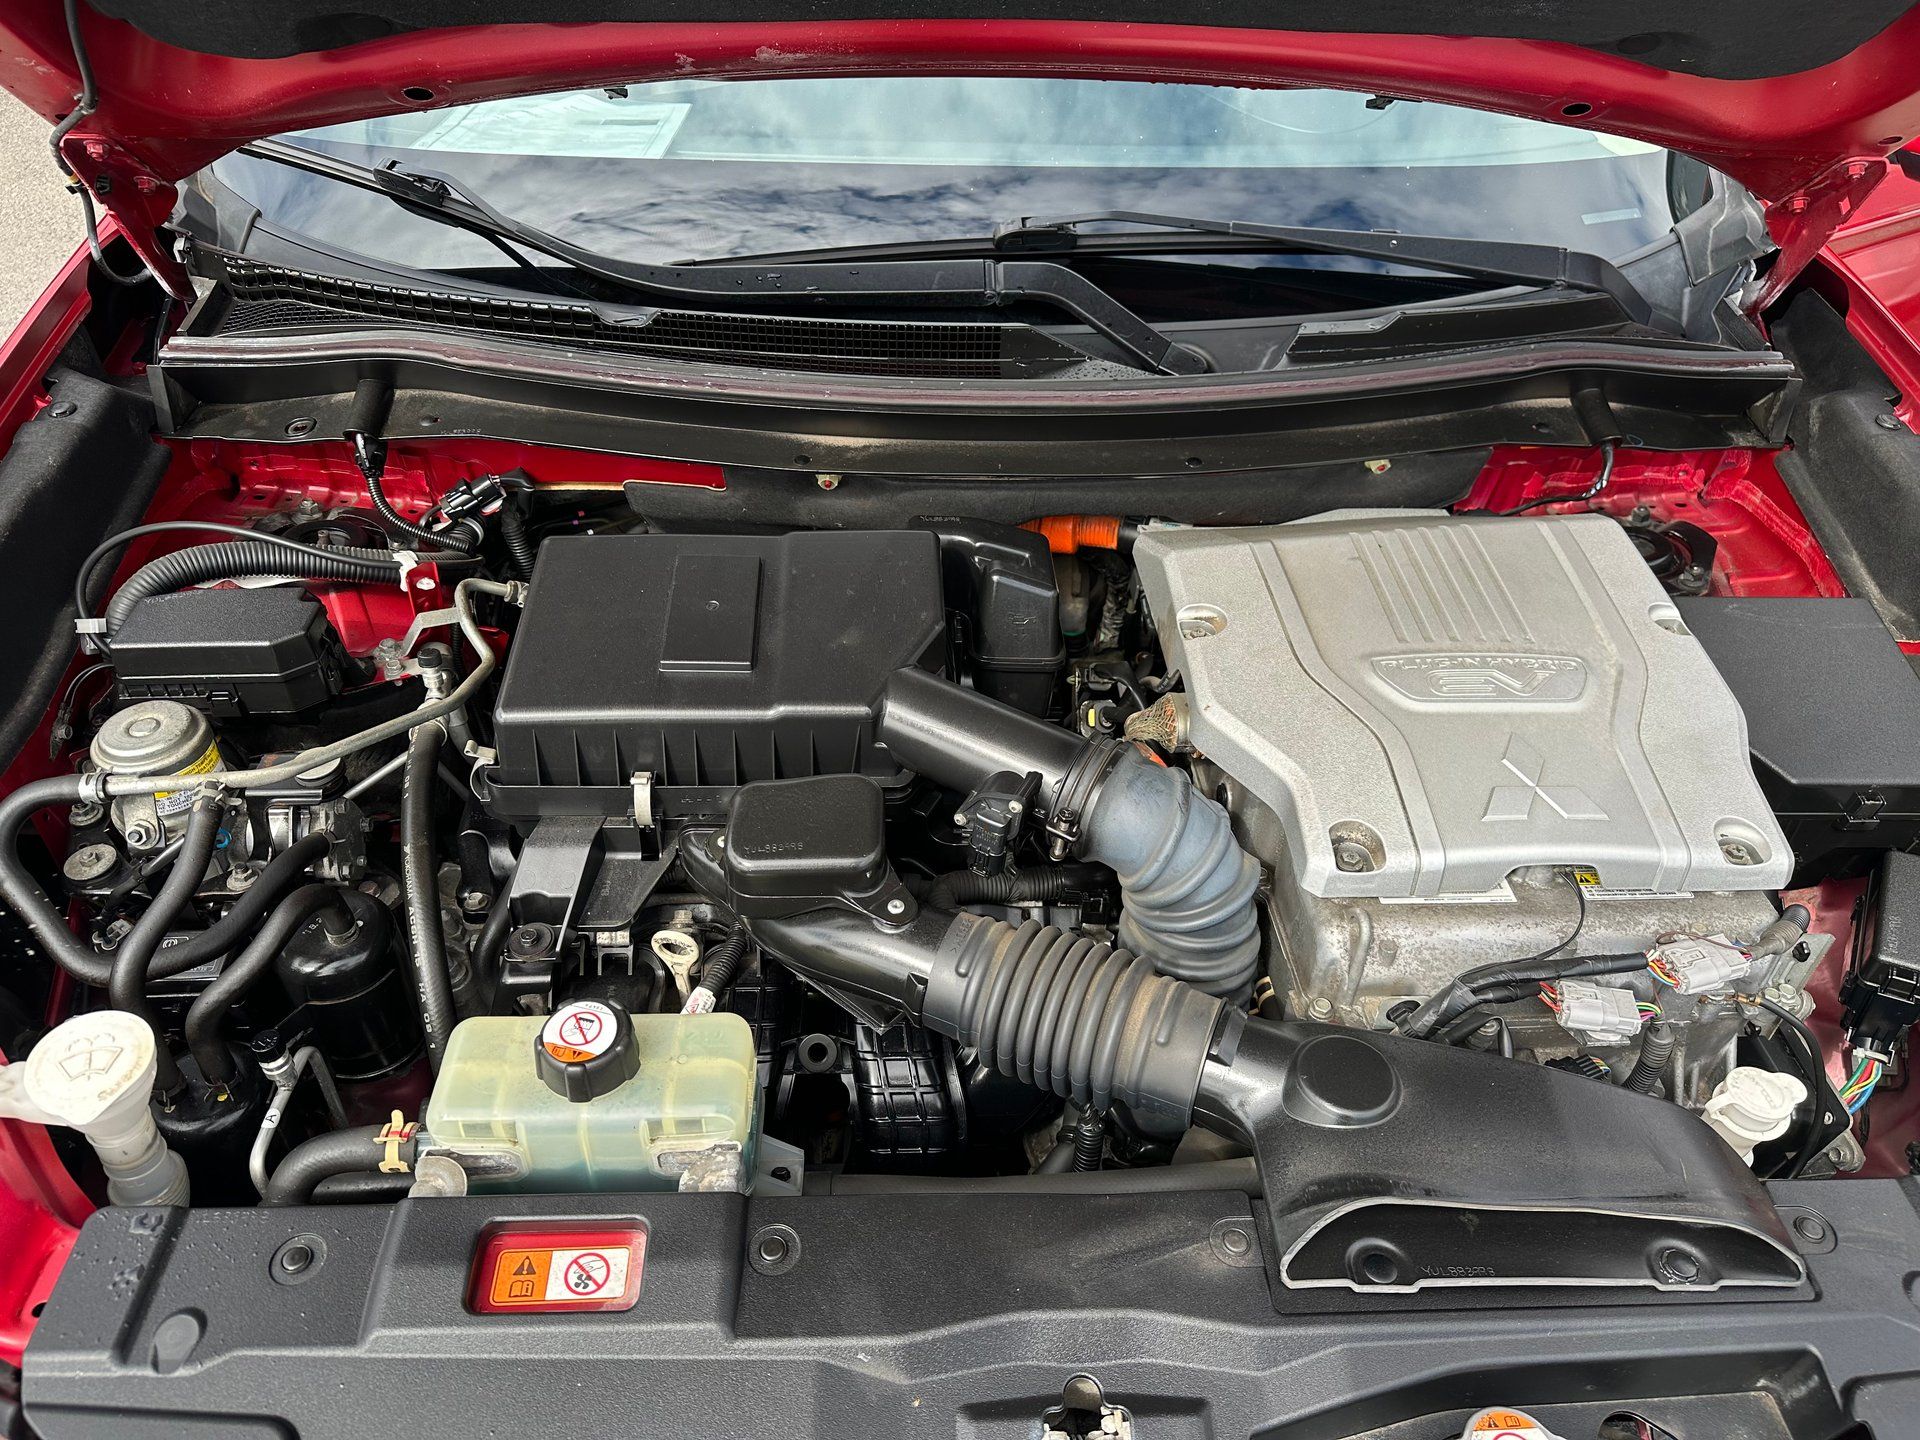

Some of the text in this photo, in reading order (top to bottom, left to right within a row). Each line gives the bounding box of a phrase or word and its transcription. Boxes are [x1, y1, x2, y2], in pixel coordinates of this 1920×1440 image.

[1380, 657, 1579, 671] PLUG-IN HYBRID
[1426, 669, 1556, 696] EV
[418, 982, 427, 1003] HA
